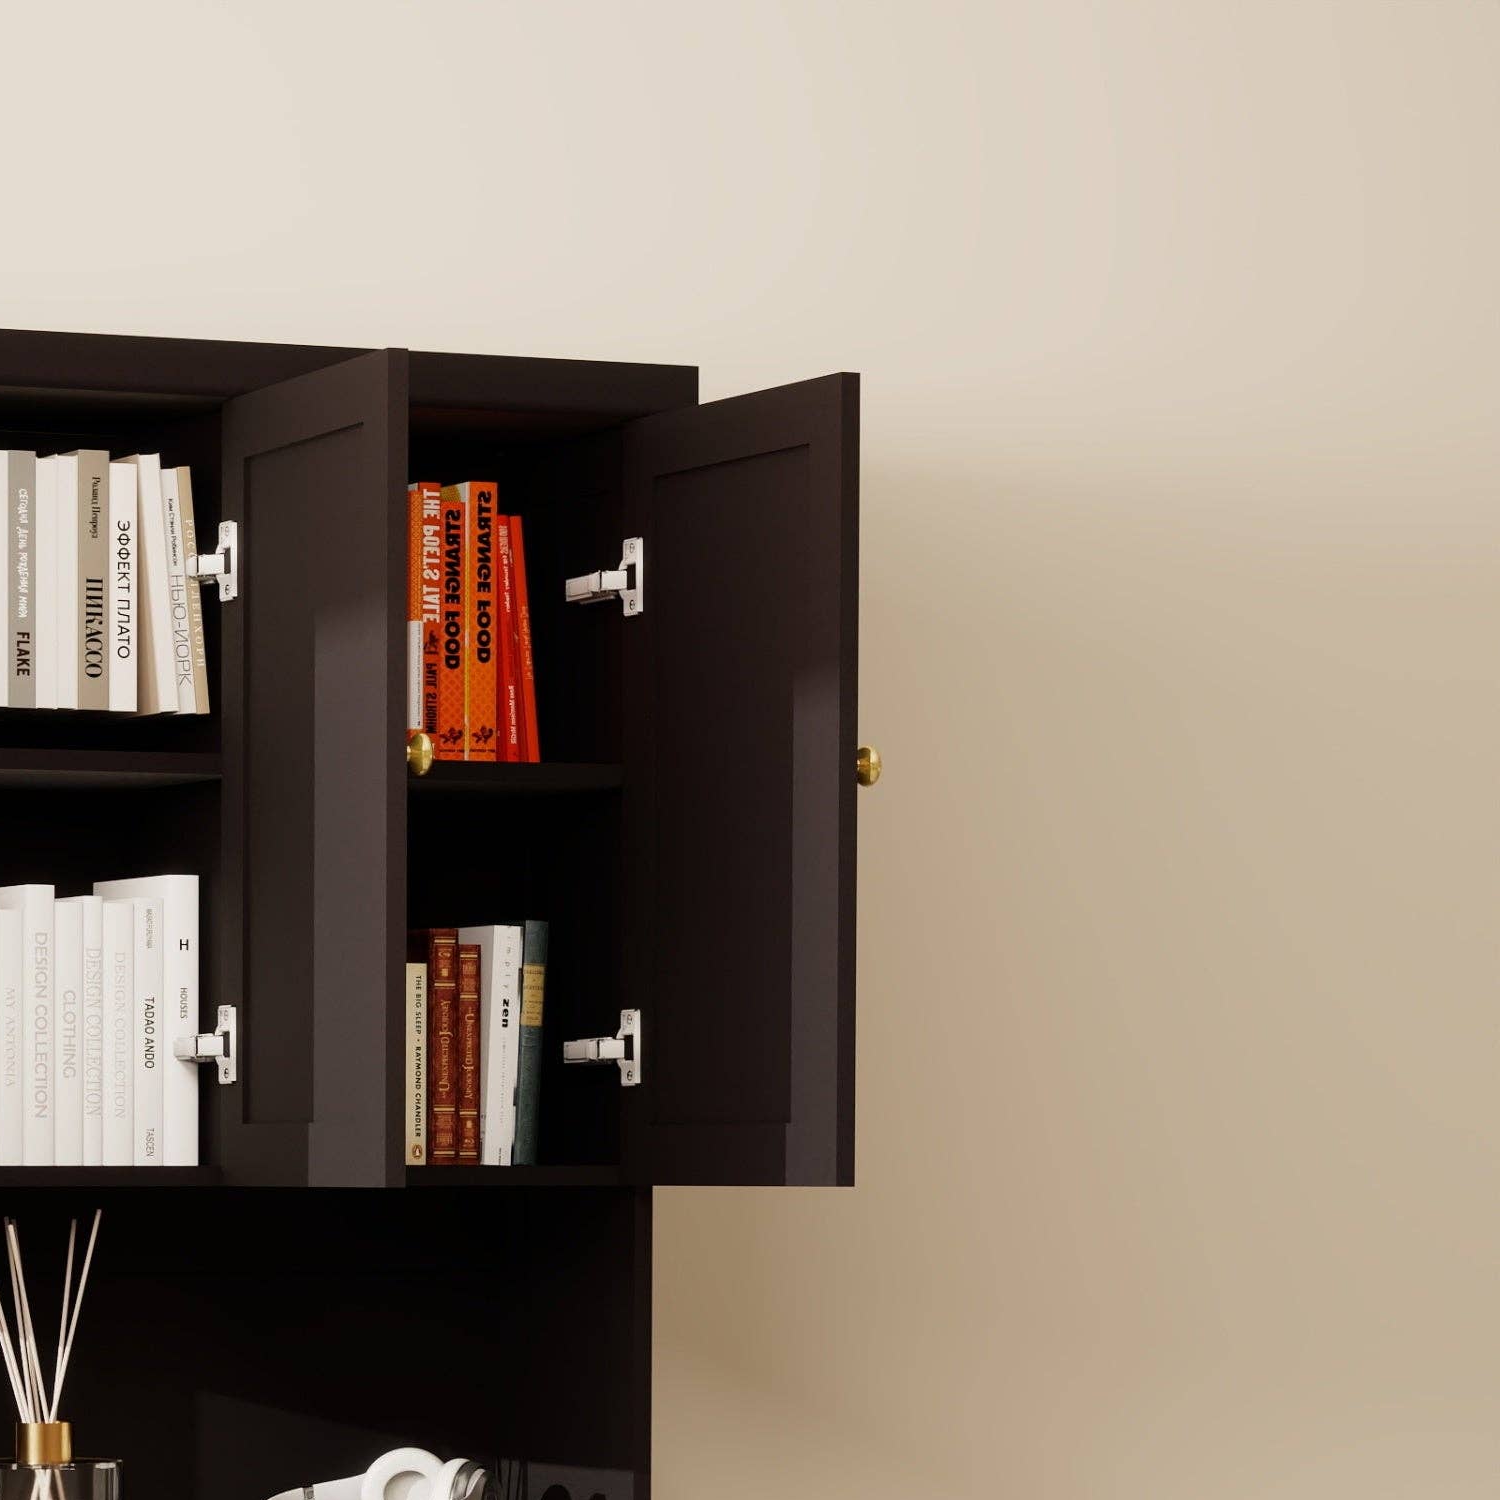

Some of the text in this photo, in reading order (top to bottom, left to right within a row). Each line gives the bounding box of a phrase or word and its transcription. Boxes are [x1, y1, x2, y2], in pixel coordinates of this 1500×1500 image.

[16, 527, 28, 550] ДЕНЬ
[17, 595, 28, 618] МИРА
[85, 577, 103, 678] ПИКАССО
[116, 520, 131, 659] ЭФФЕКТ ПЛАТО
[16, 631, 30, 676] FLAKE
[34, 931, 48, 1119] DESIGN COLLECTION
[62, 989, 77, 1079] CLOTHING
[85, 948, 102, 1117] DESIGN COLLECTION
[144, 997, 155, 1069] TADAO ANDO
[180, 987, 188, 1019] HOUSES
[502, 998, 510, 1028] zen
[414, 975, 422, 1138] THE BIG SLEEP RAYMOND CHANDLER
